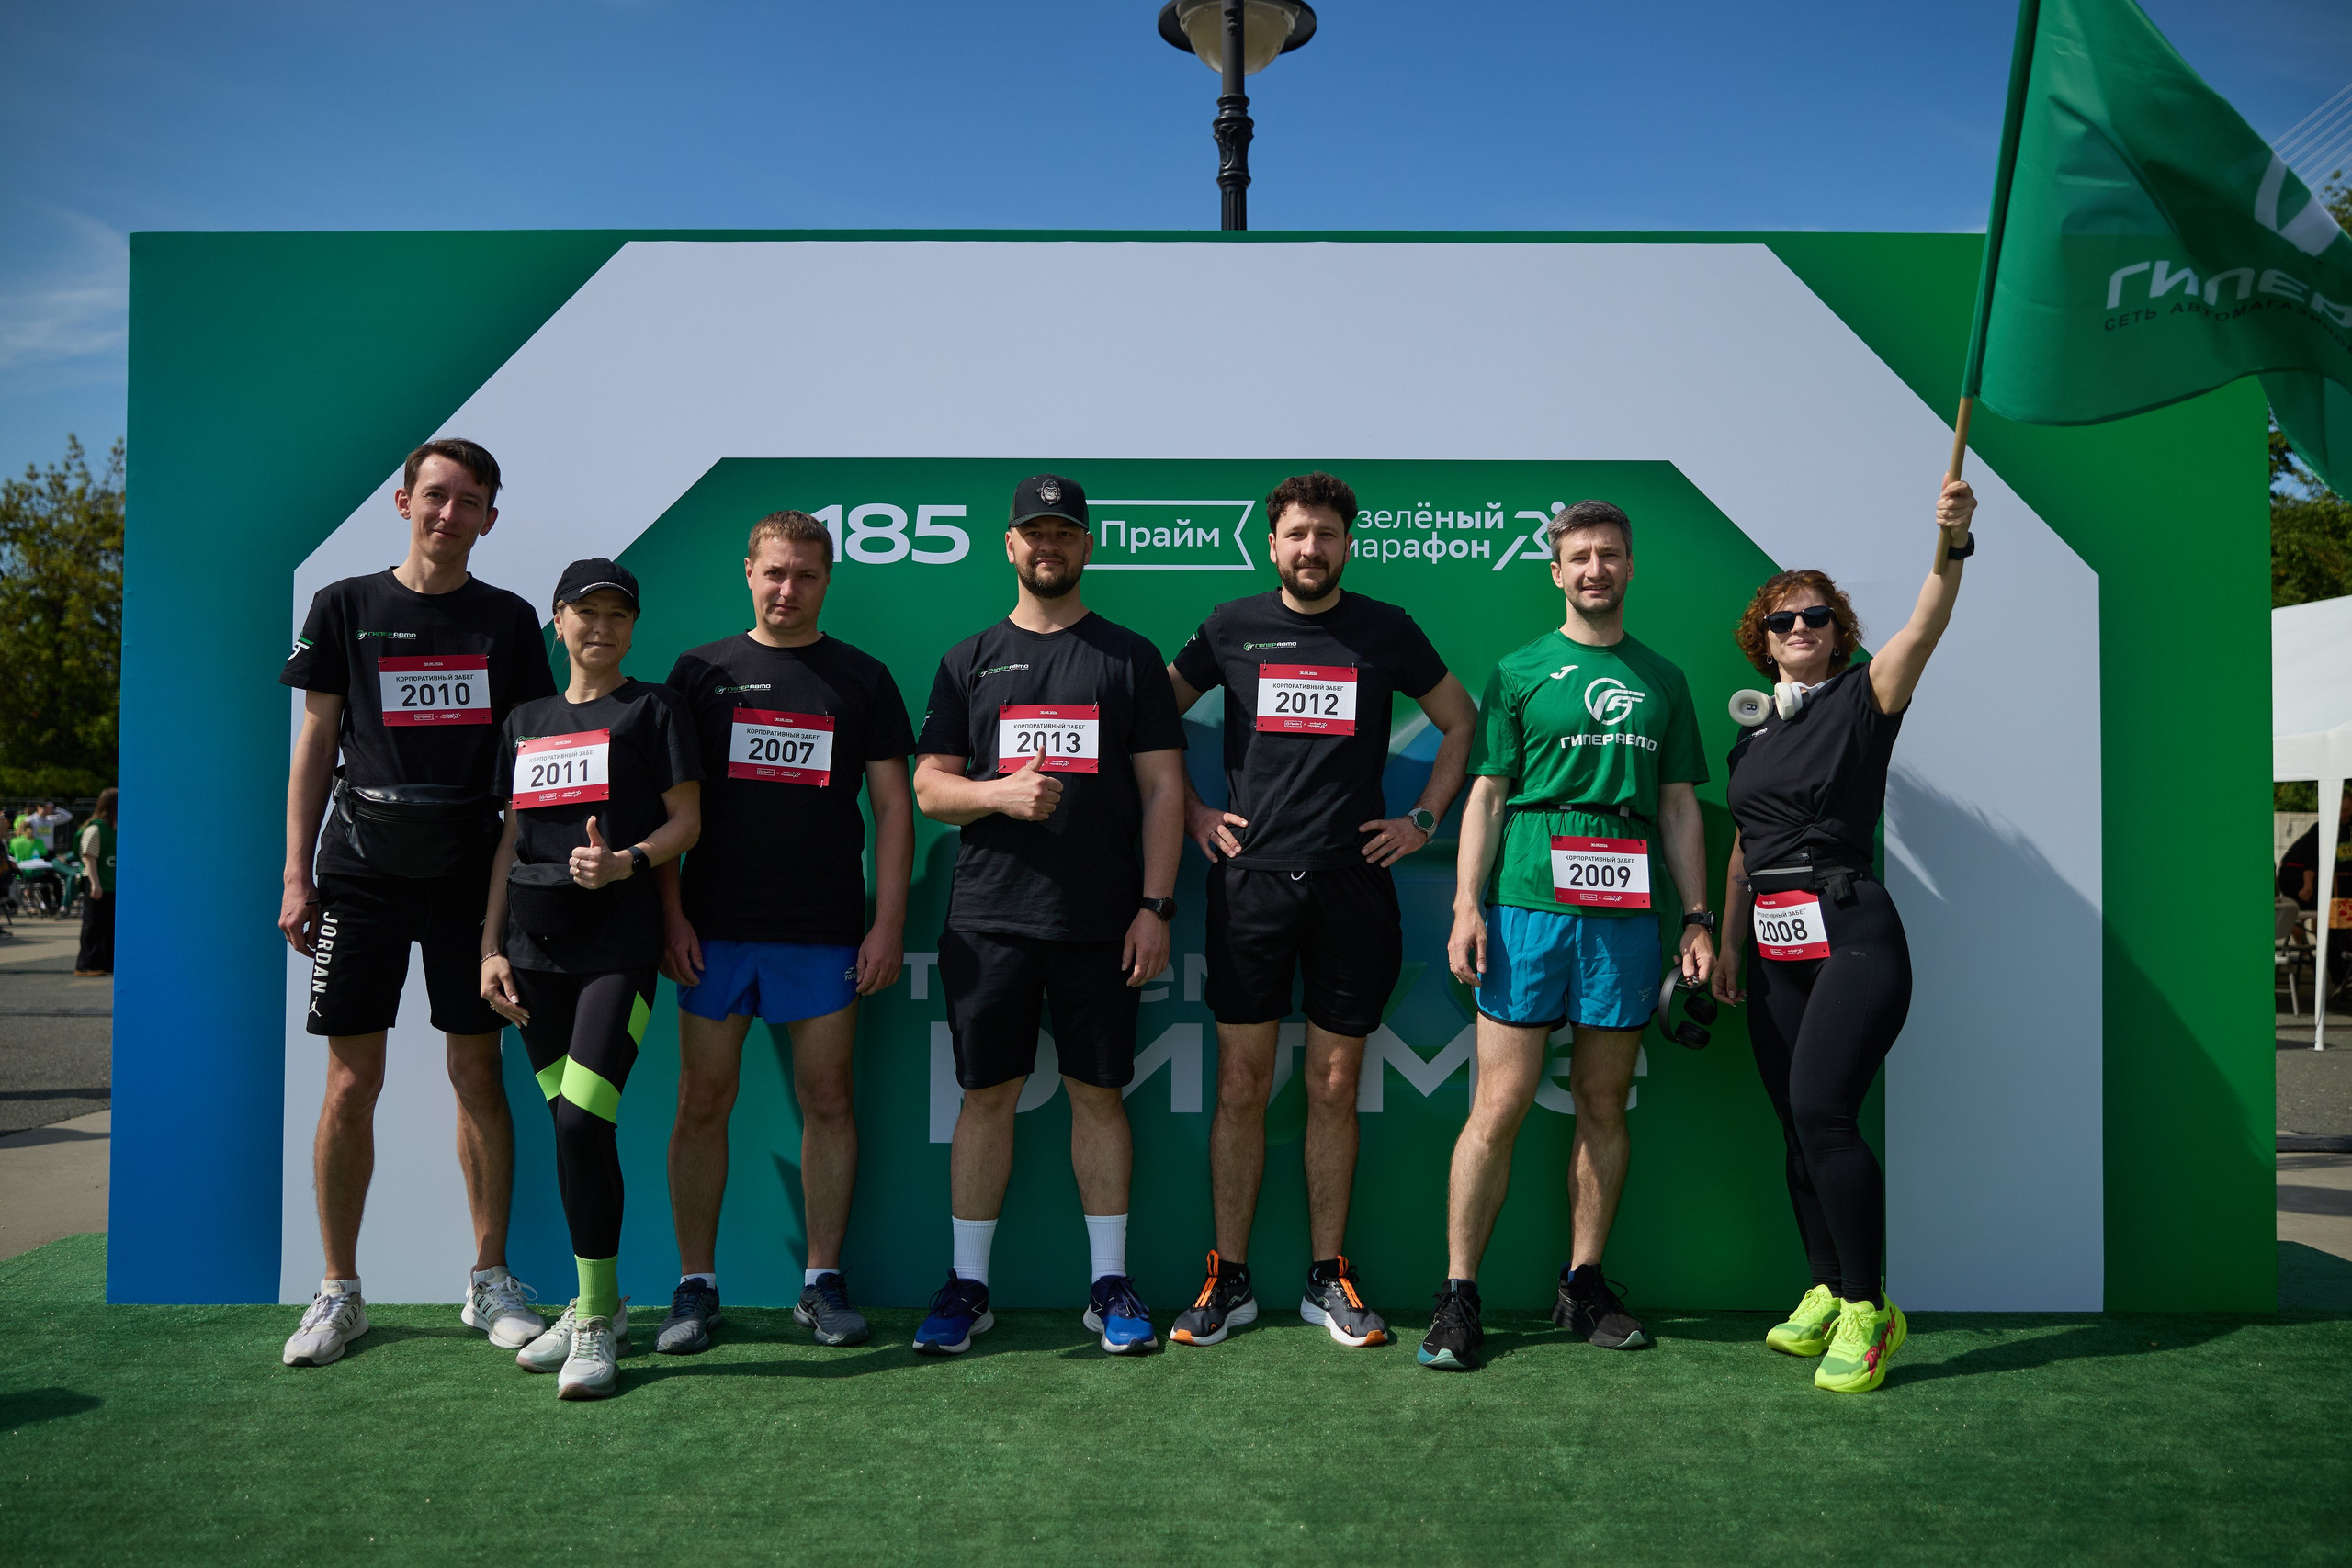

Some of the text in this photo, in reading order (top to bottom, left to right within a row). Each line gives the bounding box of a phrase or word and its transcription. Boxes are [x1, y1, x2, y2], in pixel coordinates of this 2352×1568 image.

[2103, 310, 2157, 331] СЕТЬ
[1357, 502, 1504, 529] зелёный
[809, 502, 970, 564] 185
[1101, 518, 1220, 553] Прайм
[395, 673, 453, 682] КОРПОРАТИВНЫЙ
[1272, 682, 1325, 691] КОРПОРАТИВНЫЙ
[401, 682, 470, 707] 2010
[1275, 691, 1339, 716] 2012
[1746, 703, 1758, 711] R
[746, 728, 800, 739] КОРПОРАТИВНЫЙ
[1016, 731, 1080, 754] 2013
[1560, 732, 1657, 752] ГИПЕРАВТО
[579, 749, 596, 757] ЗАБЕГ
[748, 737, 815, 764] 2007
[530, 759, 588, 788] 2011
[1565, 854, 1616, 863] КОРПОРАТИВНЫЙ
[1569, 863, 1631, 888] 2009
[1788, 908, 1807, 917] ЗАБЕГ
[1758, 919, 1808, 942] 2008
[311, 911, 339, 994] JORDAN
